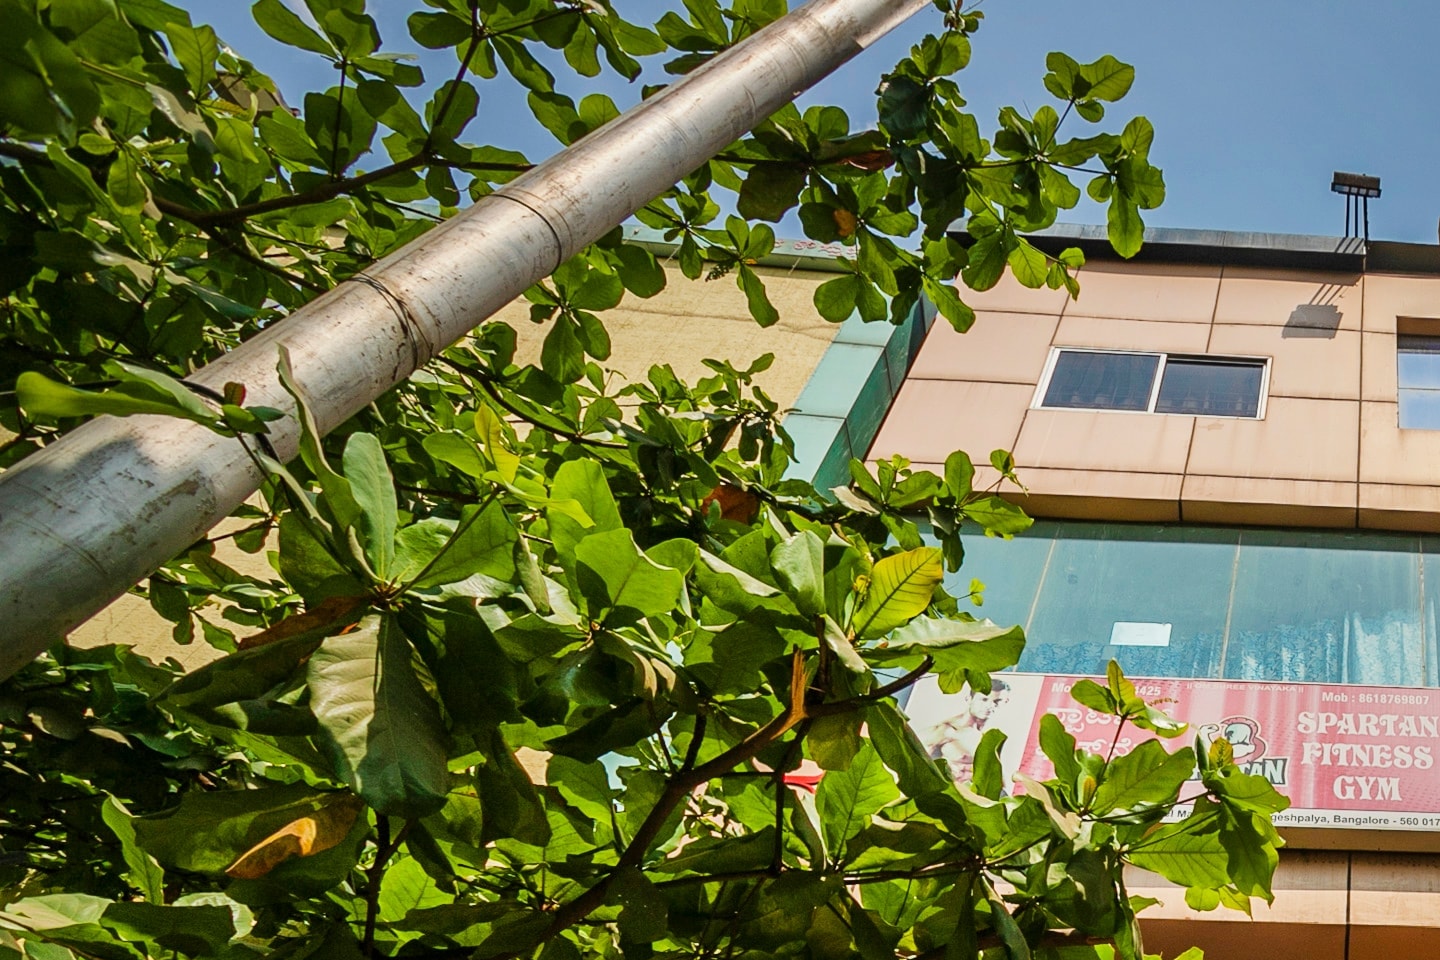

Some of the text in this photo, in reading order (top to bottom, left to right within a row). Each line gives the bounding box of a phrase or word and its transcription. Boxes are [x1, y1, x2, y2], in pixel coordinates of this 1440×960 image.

[1248, 684, 1296, 692] VINAYAKA
[1322, 692, 1348, 703] Mob
[1358, 693, 1430, 705] 8618769807
[1297, 711, 1440, 738] SPARTAN
[1300, 741, 1434, 770] FITNESS
[1333, 775, 1403, 801] GYM
[1333, 815, 1389, 826] Bangalore
[1399, 817, 1419, 826] 560
[1422, 818, 1440, 826] 017
